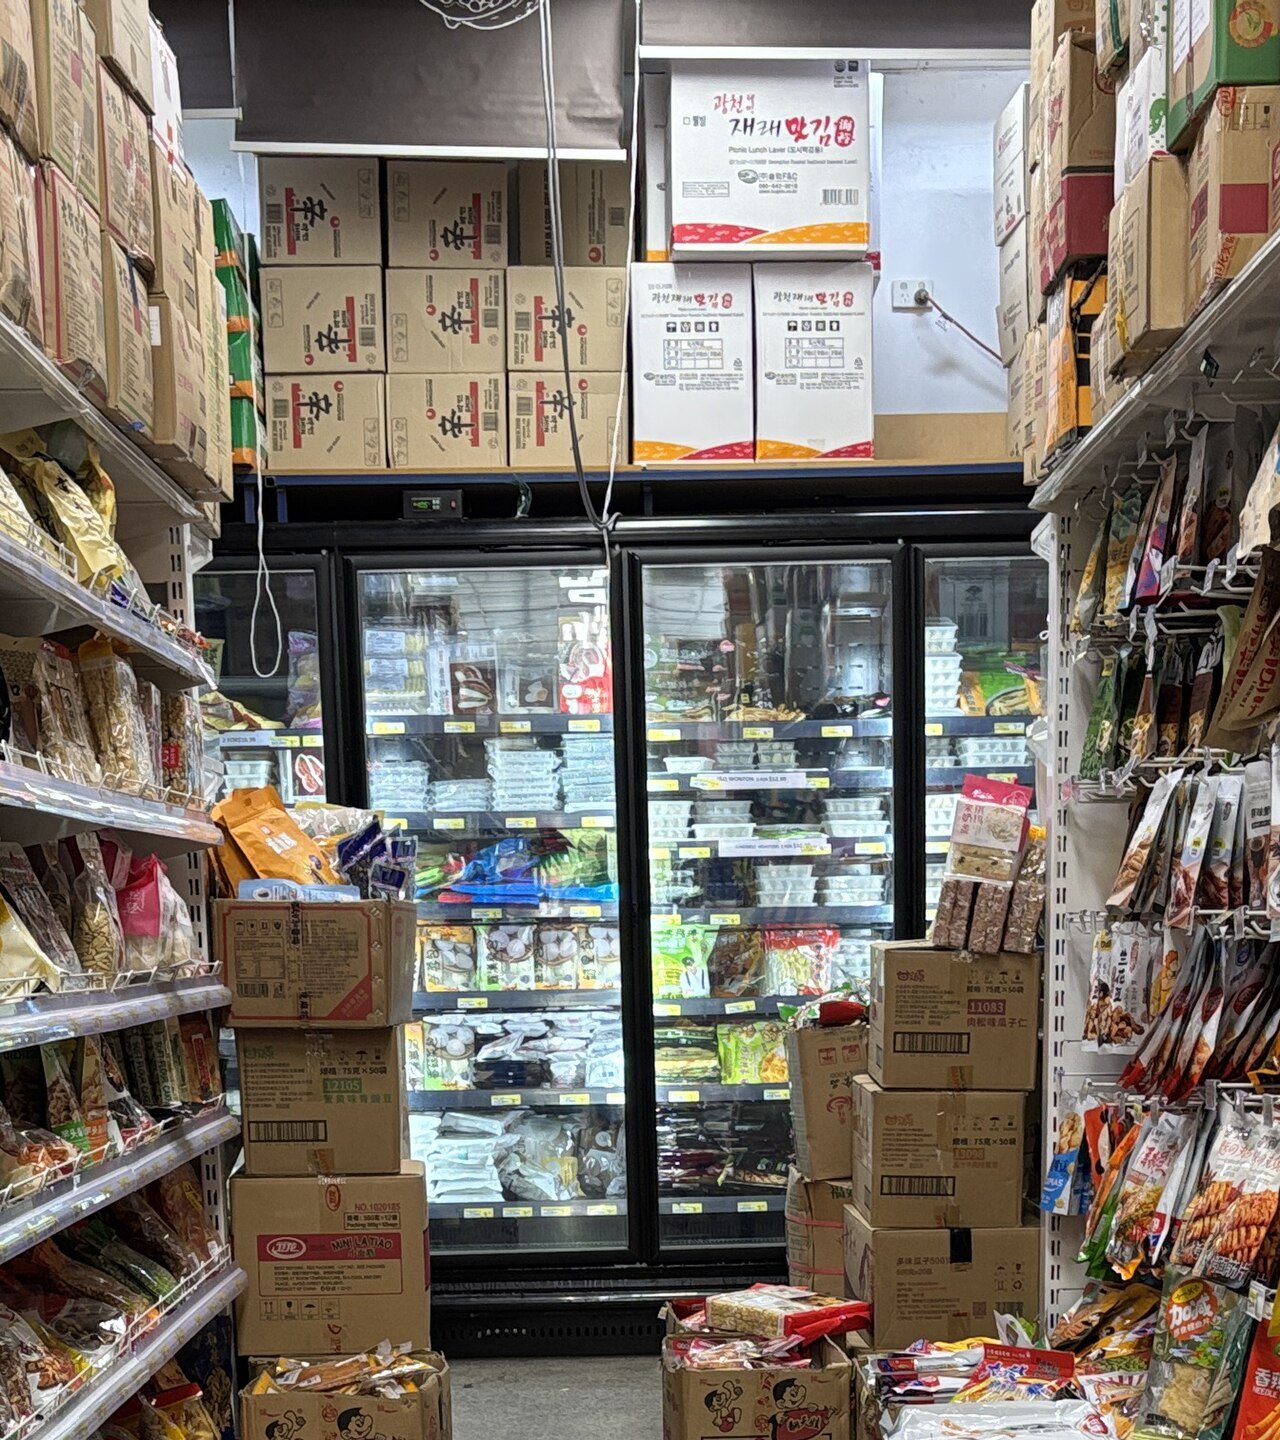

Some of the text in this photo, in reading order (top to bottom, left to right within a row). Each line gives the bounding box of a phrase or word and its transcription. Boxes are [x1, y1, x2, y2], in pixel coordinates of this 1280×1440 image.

[970, 1001, 1005, 1013] 11083
[331, 1236, 392, 1251] MINI LA TIAO
